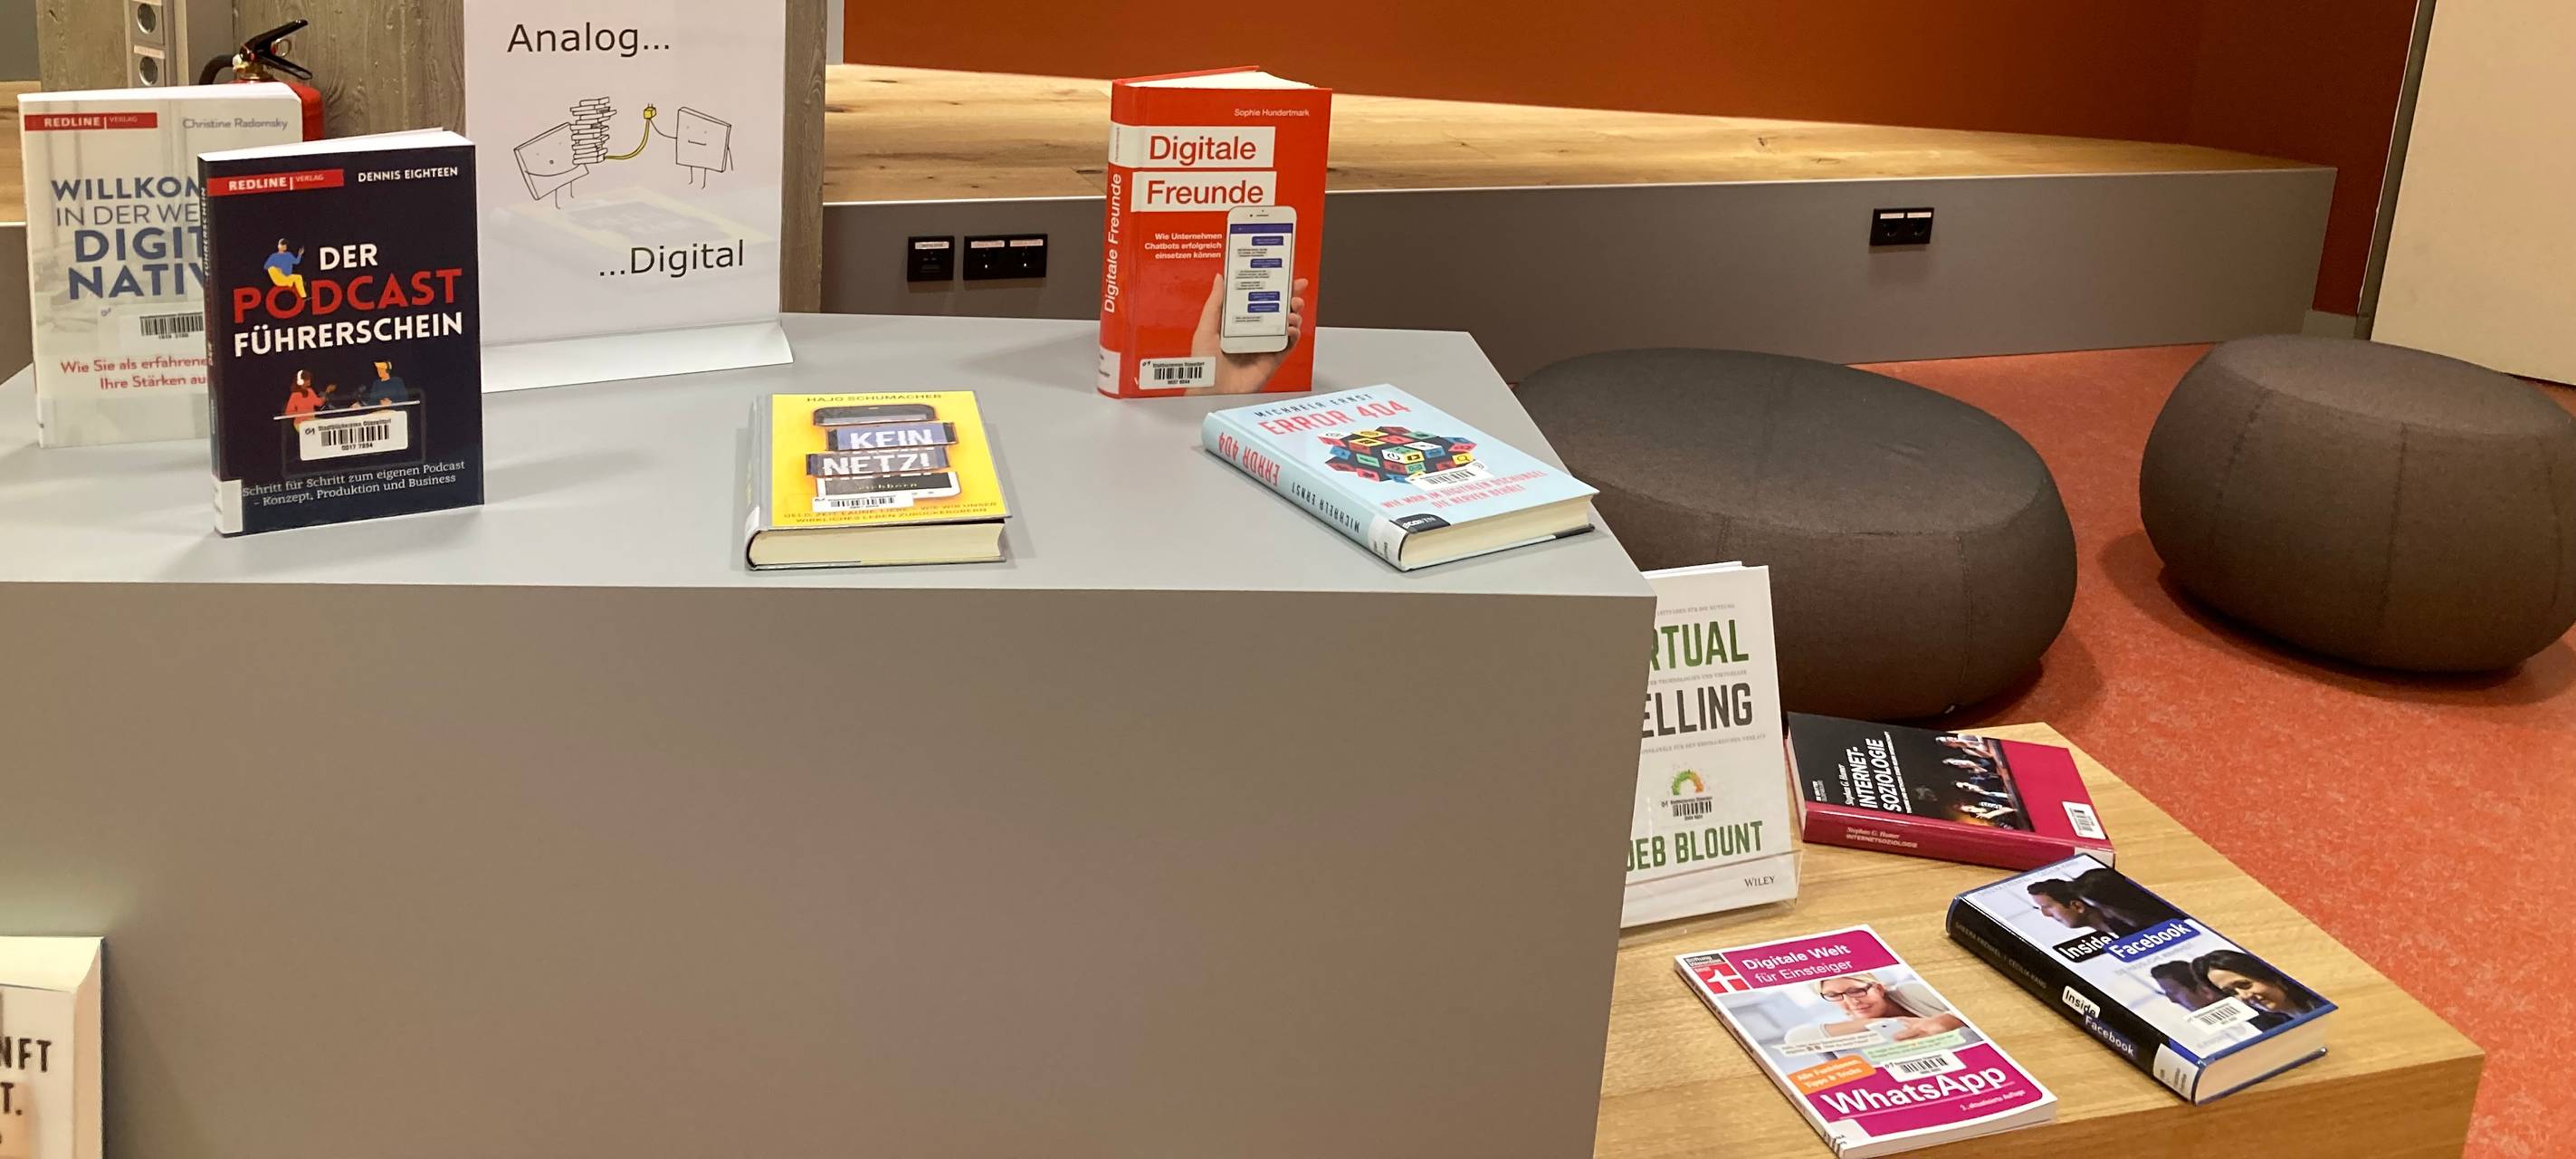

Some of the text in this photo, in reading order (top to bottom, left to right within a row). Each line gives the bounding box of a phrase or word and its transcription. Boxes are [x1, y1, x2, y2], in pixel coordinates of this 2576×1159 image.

[507, 22, 670, 57] Analog...
[43, 115, 138, 128] REDLINE VERLAG
[182, 117, 289, 131] Christine Radomsky
[1234, 108, 1310, 118] Sophie Hundertmark
[1150, 135, 1256, 167] Digitale
[228, 173, 324, 191] REDLINE VERLAG
[358, 167, 458, 183] DENNIS EIGHTEEN
[1147, 179, 1264, 205] Freunde
[56, 206, 85, 226] IN
[93, 205, 149, 226] DER
[1103, 173, 1122, 313] Digitale Freunde
[1144, 242, 1222, 251] Chatbots erfolgreich
[1171, 232, 1223, 241] Unternehmen
[320, 244, 377, 271] DER
[1155, 251, 1222, 260] einsetzen können
[233, 268, 463, 324] PODCAST
[234, 311, 463, 357] FÜHRERSCHEIN
[61, 360, 89, 373] Wie
[93, 359, 116, 372] Sie
[119, 357, 136, 370] als
[100, 378, 128, 390] Ihre
[132, 373, 186, 388] Stärken
[847, 394, 942, 402] SCHUMACHER
[1255, 393, 1374, 418] MICHAELA ERNST
[1258, 399, 1412, 436] ERROR 404
[850, 429, 935, 454] KEIN
[1218, 432, 1281, 488] ERROR 404
[243, 460, 465, 497] Schritt für Schritt zum eigenen Podcast
[317, 483, 382, 499] Produktion
[384, 479, 405, 492] und
[408, 474, 456, 489] Business
[1291, 482, 1360, 533] MICHAELA ERNST
[1846, 746, 1878, 809] INTERNET-
[1865, 738, 1902, 812] SOZIOLOGIE
[1674, 820, 1763, 864] BLOUNT
[1744, 876, 1776, 888] WILEY
[2058, 935, 2114, 960] Inside
[2109, 922, 2191, 959] Facebook
[1741, 944, 1852, 971] Digitale Welt
[1754, 960, 1854, 984] für Einsteiger
[2065, 990, 2135, 1058] Inside Facebook
[1797, 1072, 1815, 1082] Alle
[1804, 1078, 1828, 1088] Tipps
[1836, 1068, 1863, 1078] Tricks
[1819, 1067, 2007, 1115] WhatsApp
